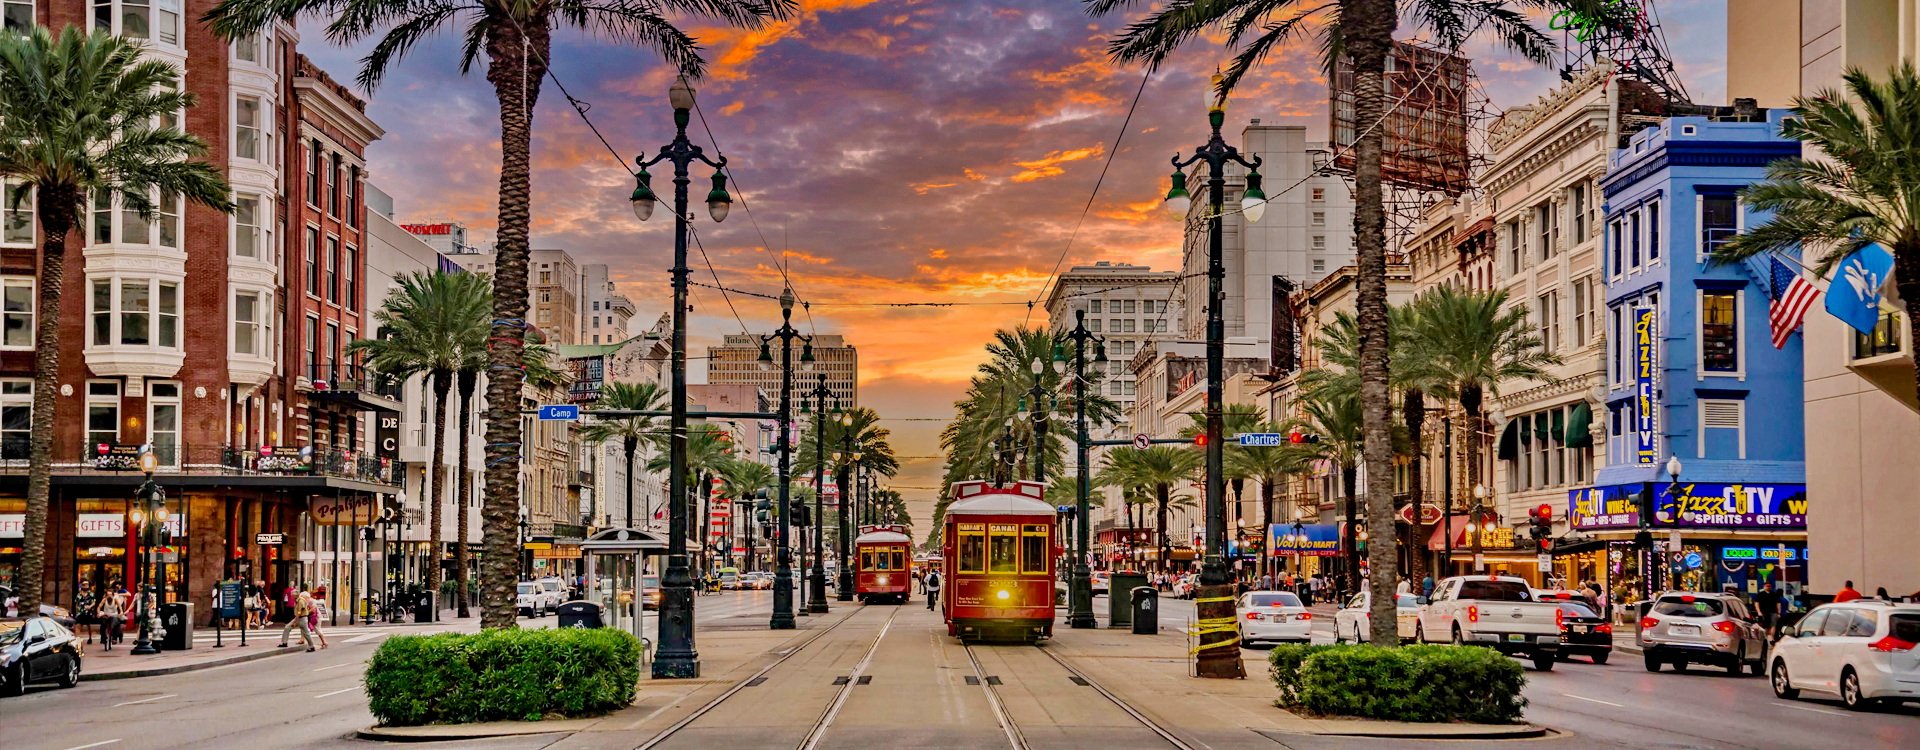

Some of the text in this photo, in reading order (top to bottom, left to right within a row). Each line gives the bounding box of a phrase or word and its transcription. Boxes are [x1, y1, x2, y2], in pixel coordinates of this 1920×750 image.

[726, 336, 751, 345] Tulane
[1636, 311, 1652, 378] JAZZ
[551, 407, 571, 418] Camp
[382, 418, 398, 429] DE
[1245, 434, 1279, 445] Chartres
[1606, 500, 1624, 515] WINE
[1662, 484, 1727, 523] Jazz
[1695, 514, 1743, 525] SPIRITS
[1756, 514, 1792, 525] GIFTS
[81, 520, 121, 531] GIFTS
[1313, 541, 1337, 549] MART
